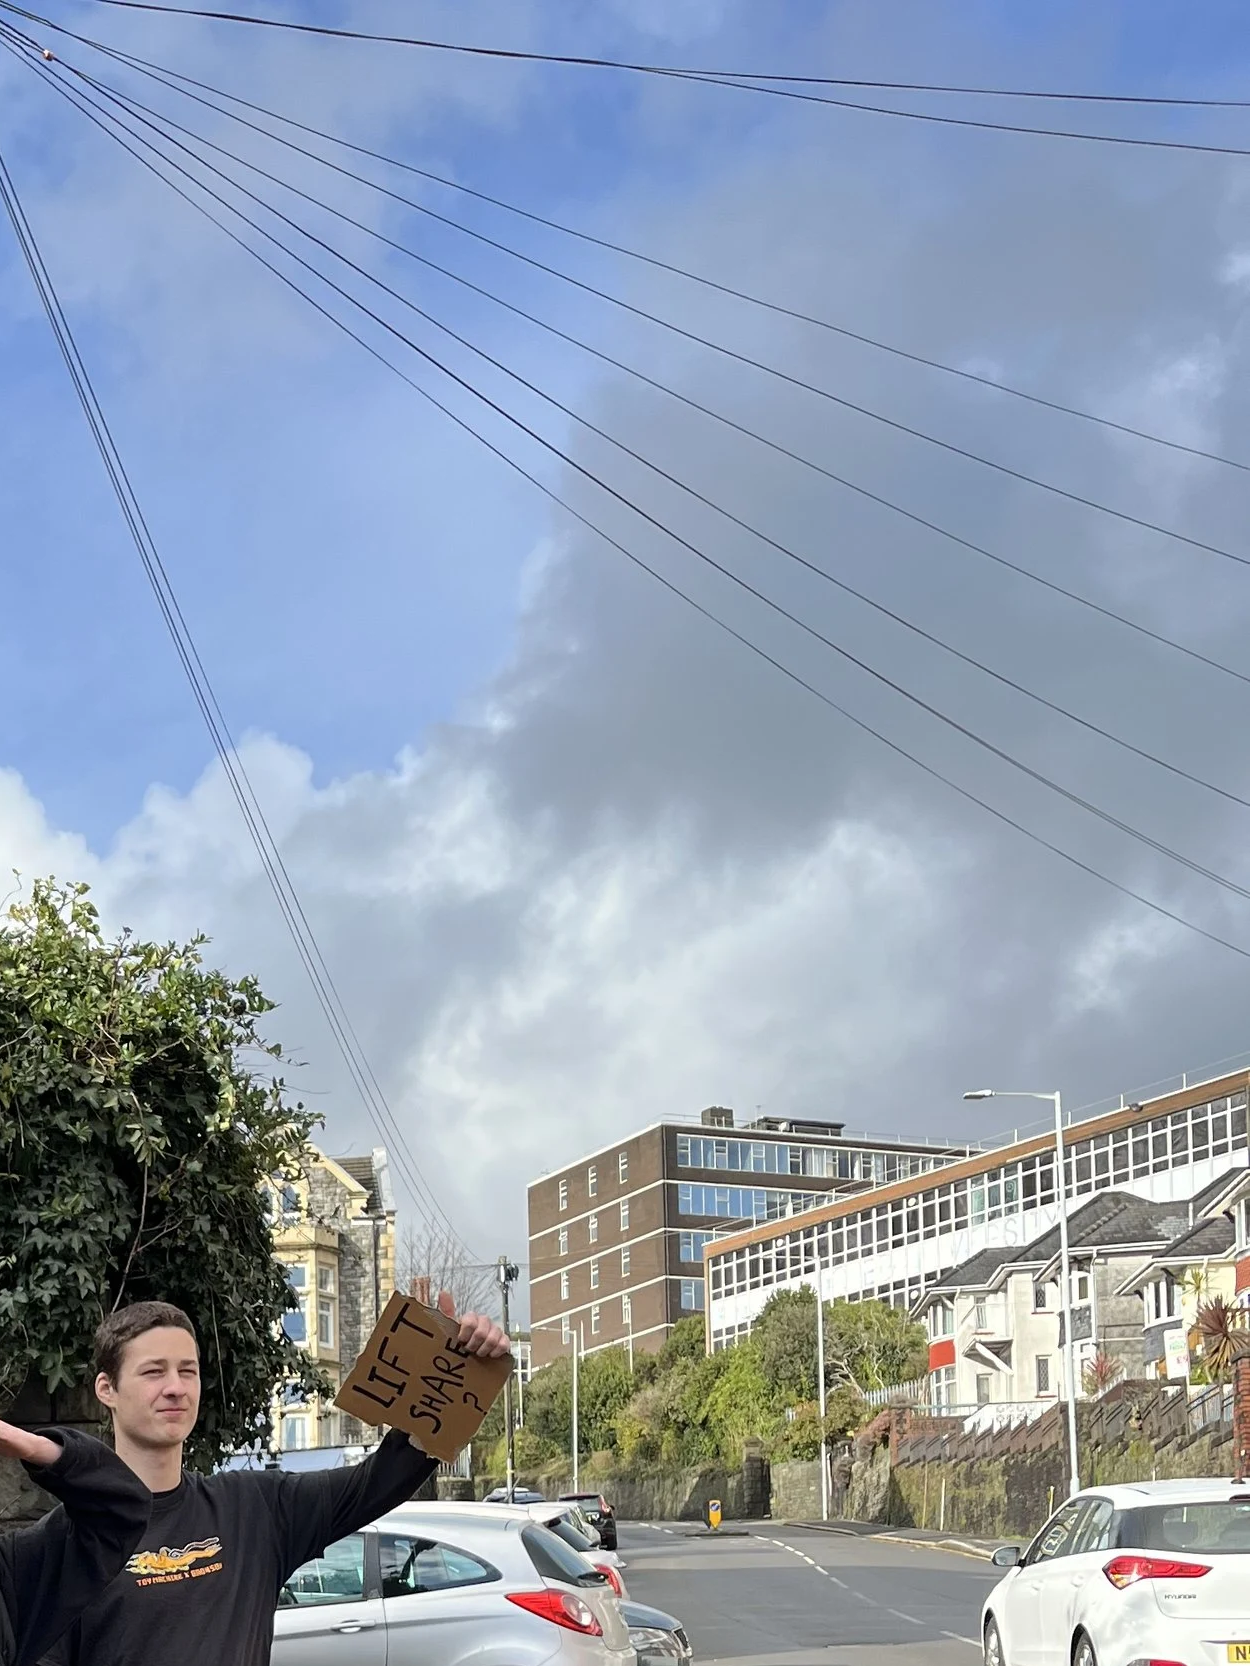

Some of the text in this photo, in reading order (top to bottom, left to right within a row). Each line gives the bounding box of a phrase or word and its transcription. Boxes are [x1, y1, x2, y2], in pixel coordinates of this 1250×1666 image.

[352, 1302, 434, 1408] LIFT
[410, 1337, 470, 1434] SHARE
[463, 1391, 487, 1416] ?
[136, 1578, 152, 1587] TOY
